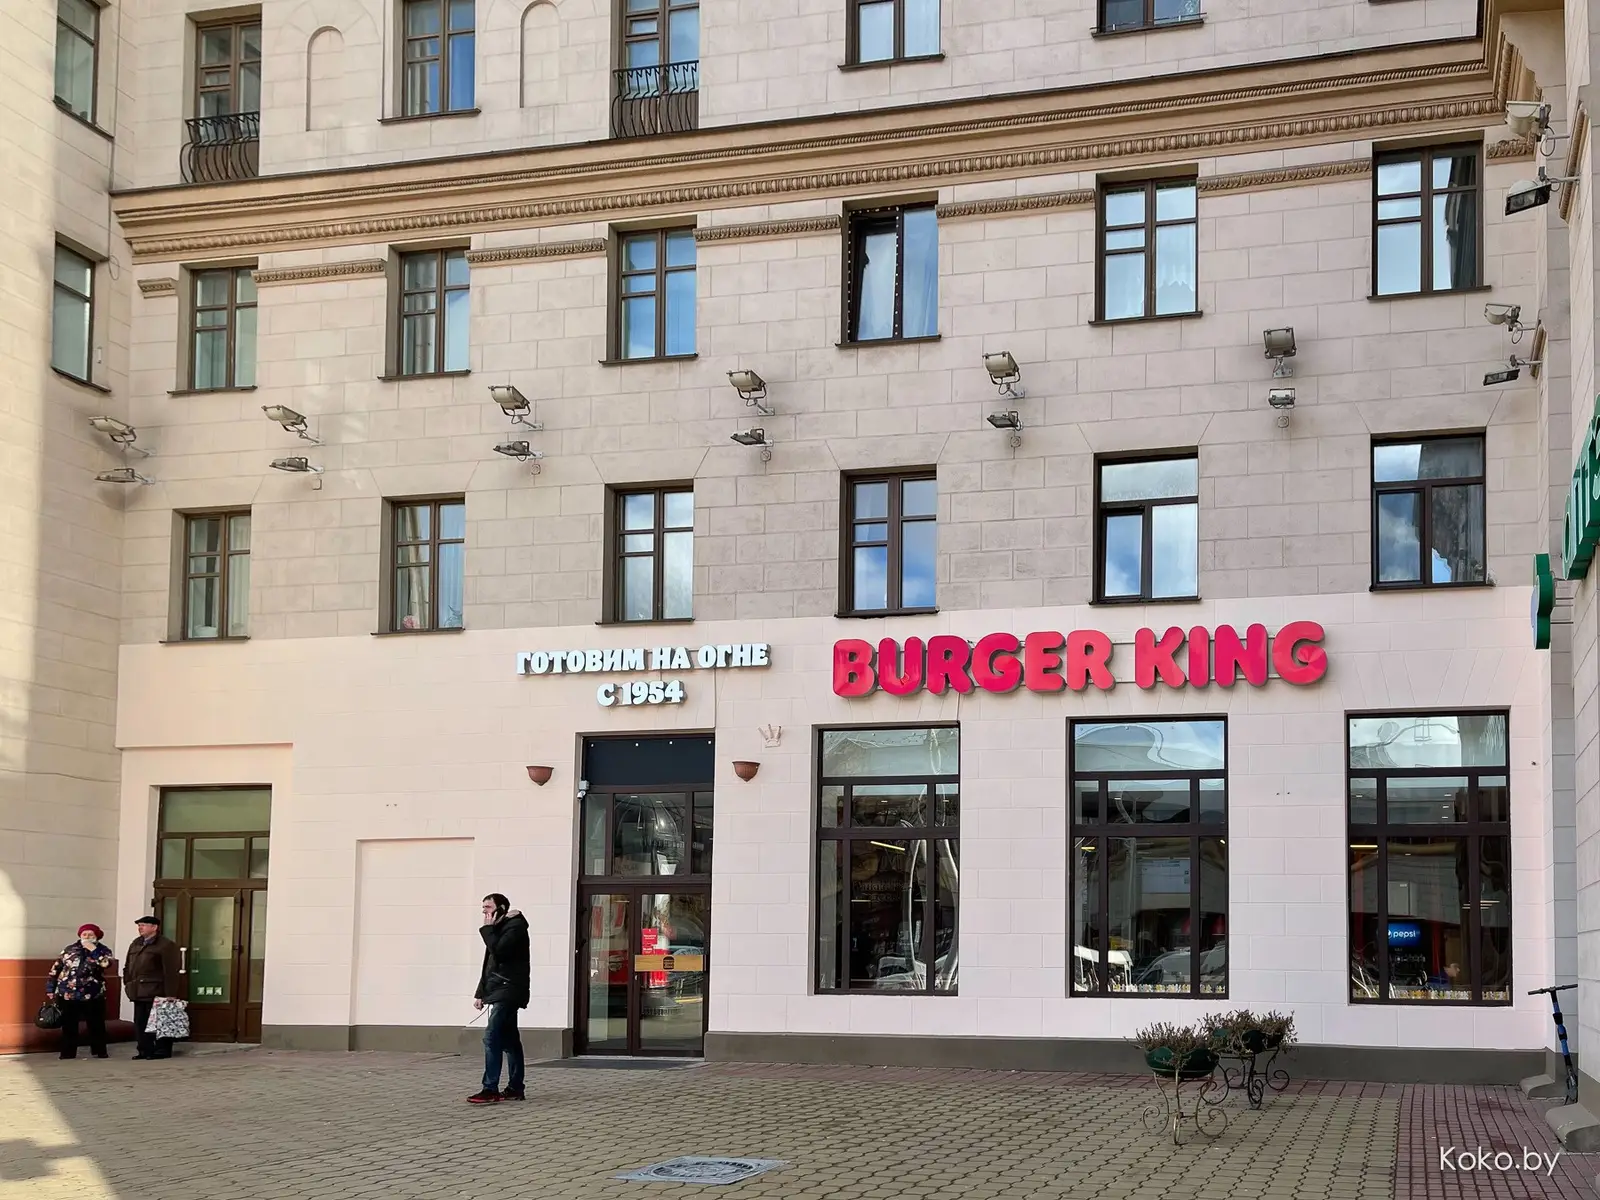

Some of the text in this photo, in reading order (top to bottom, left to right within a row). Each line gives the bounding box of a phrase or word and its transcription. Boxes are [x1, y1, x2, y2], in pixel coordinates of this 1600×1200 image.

[516, 643, 770, 675] ГОТОВИМ НА ОГНЕ
[833, 621, 1328, 698] BURGER KING
[597, 679, 686, 707] С 1954
[1393, 930, 1416, 938] pepsi
